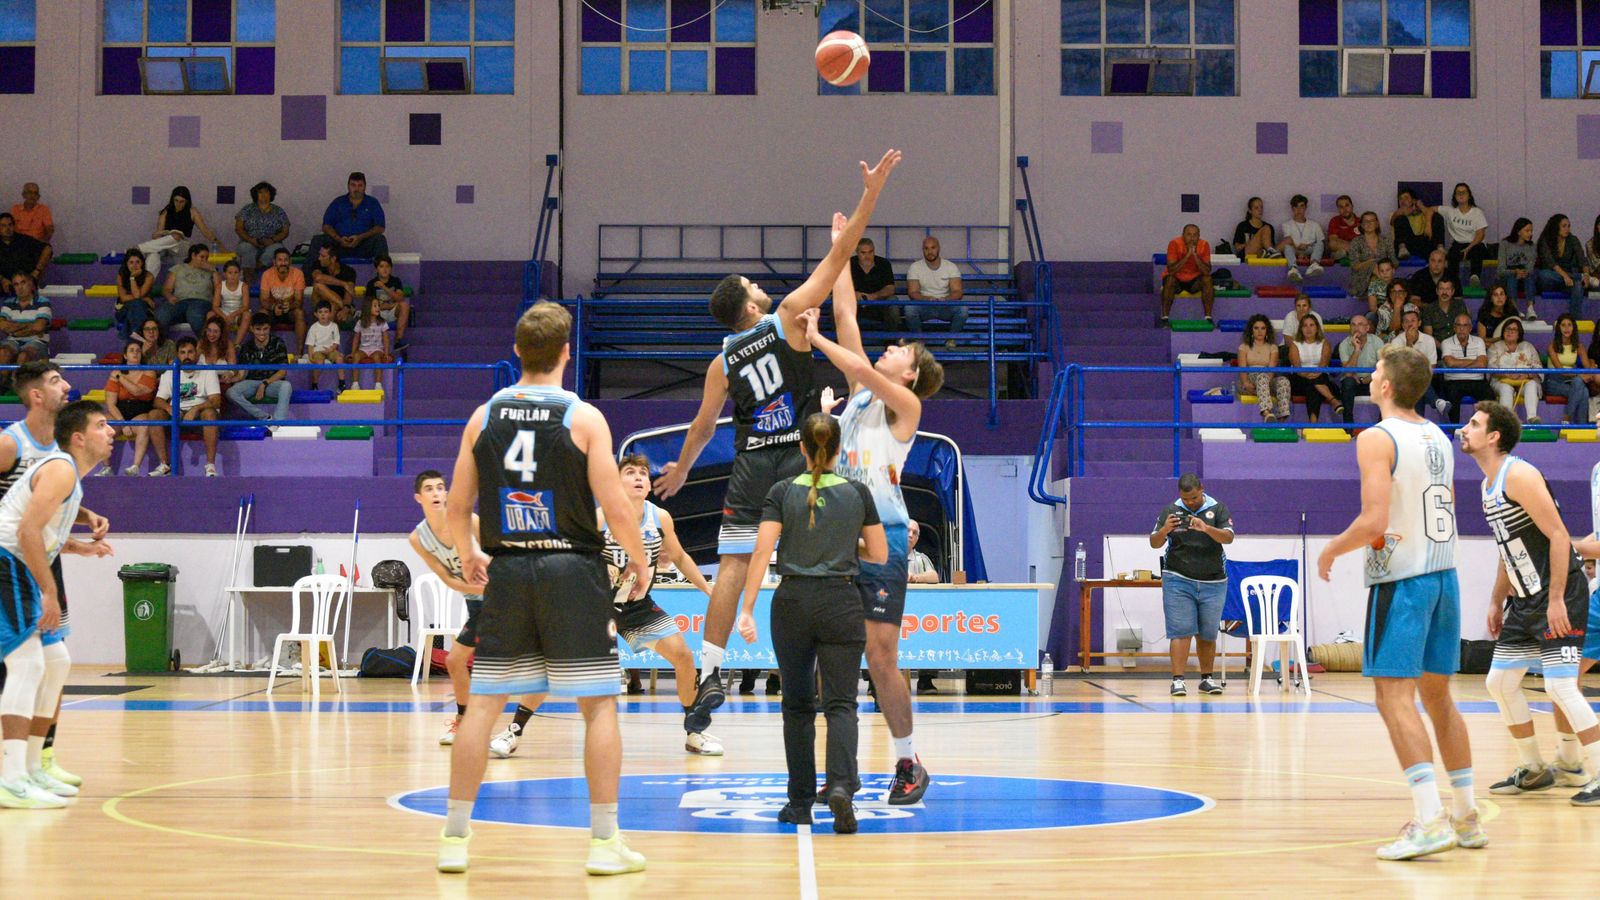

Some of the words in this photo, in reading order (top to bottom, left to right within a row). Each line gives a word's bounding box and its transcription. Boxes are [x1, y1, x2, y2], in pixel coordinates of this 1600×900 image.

[727, 355, 740, 365] EL
[738, 352, 784, 401] 10
[500, 407, 550, 421] FURLÁN
[503, 429, 538, 482] 4
[1422, 483, 1455, 544] 6
[899, 610, 1000, 640] portes
[1560, 645, 1579, 664] 99
